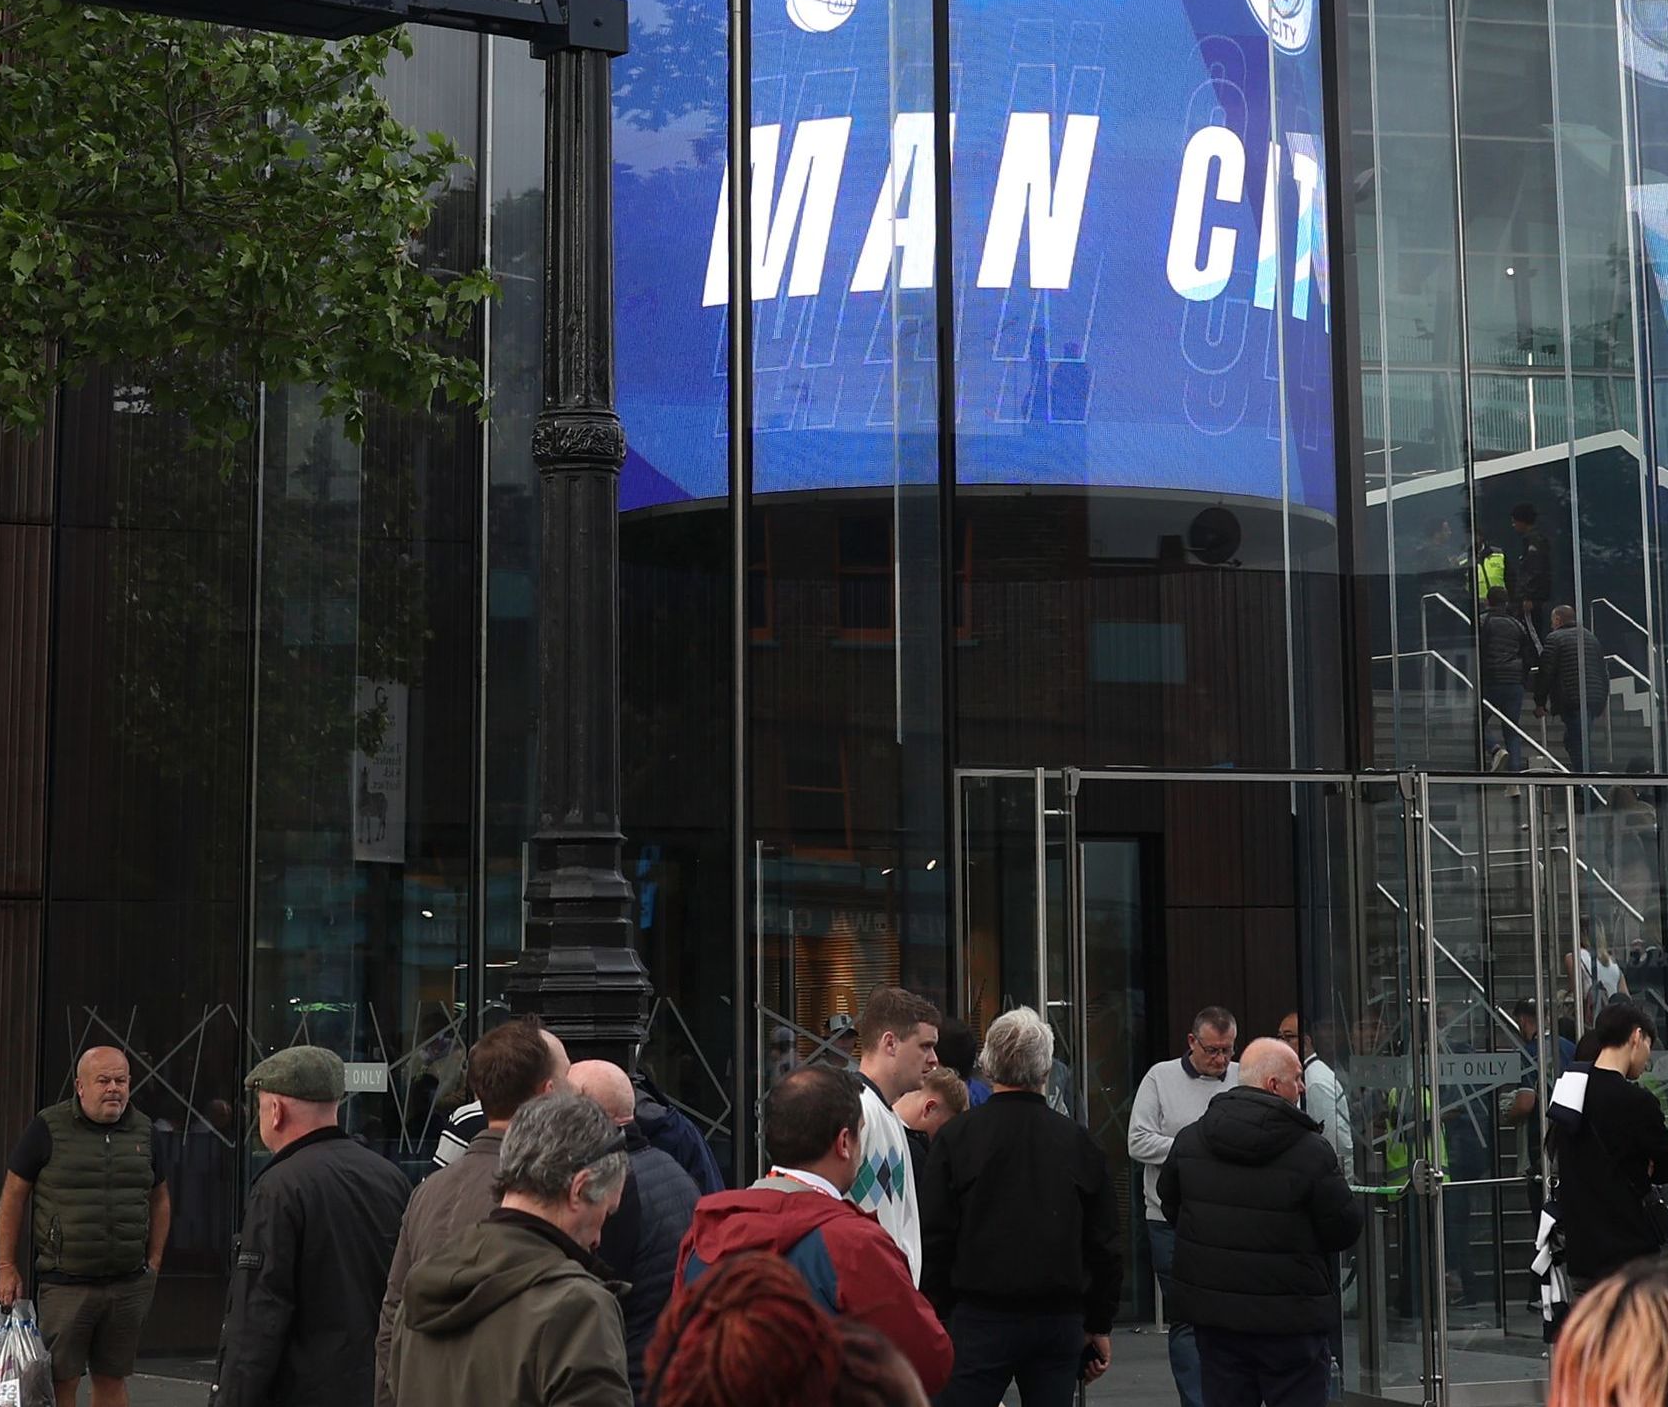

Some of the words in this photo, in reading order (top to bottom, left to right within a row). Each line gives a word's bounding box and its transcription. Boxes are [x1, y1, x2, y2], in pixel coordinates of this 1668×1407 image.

[1271, 17, 1298, 41] CITY
[702, 111, 1100, 307] MAN
[1166, 125, 1330, 334] CIT
[352, 1070, 382, 1085] ONLY
[1464, 1061, 1509, 1077] ONLY
